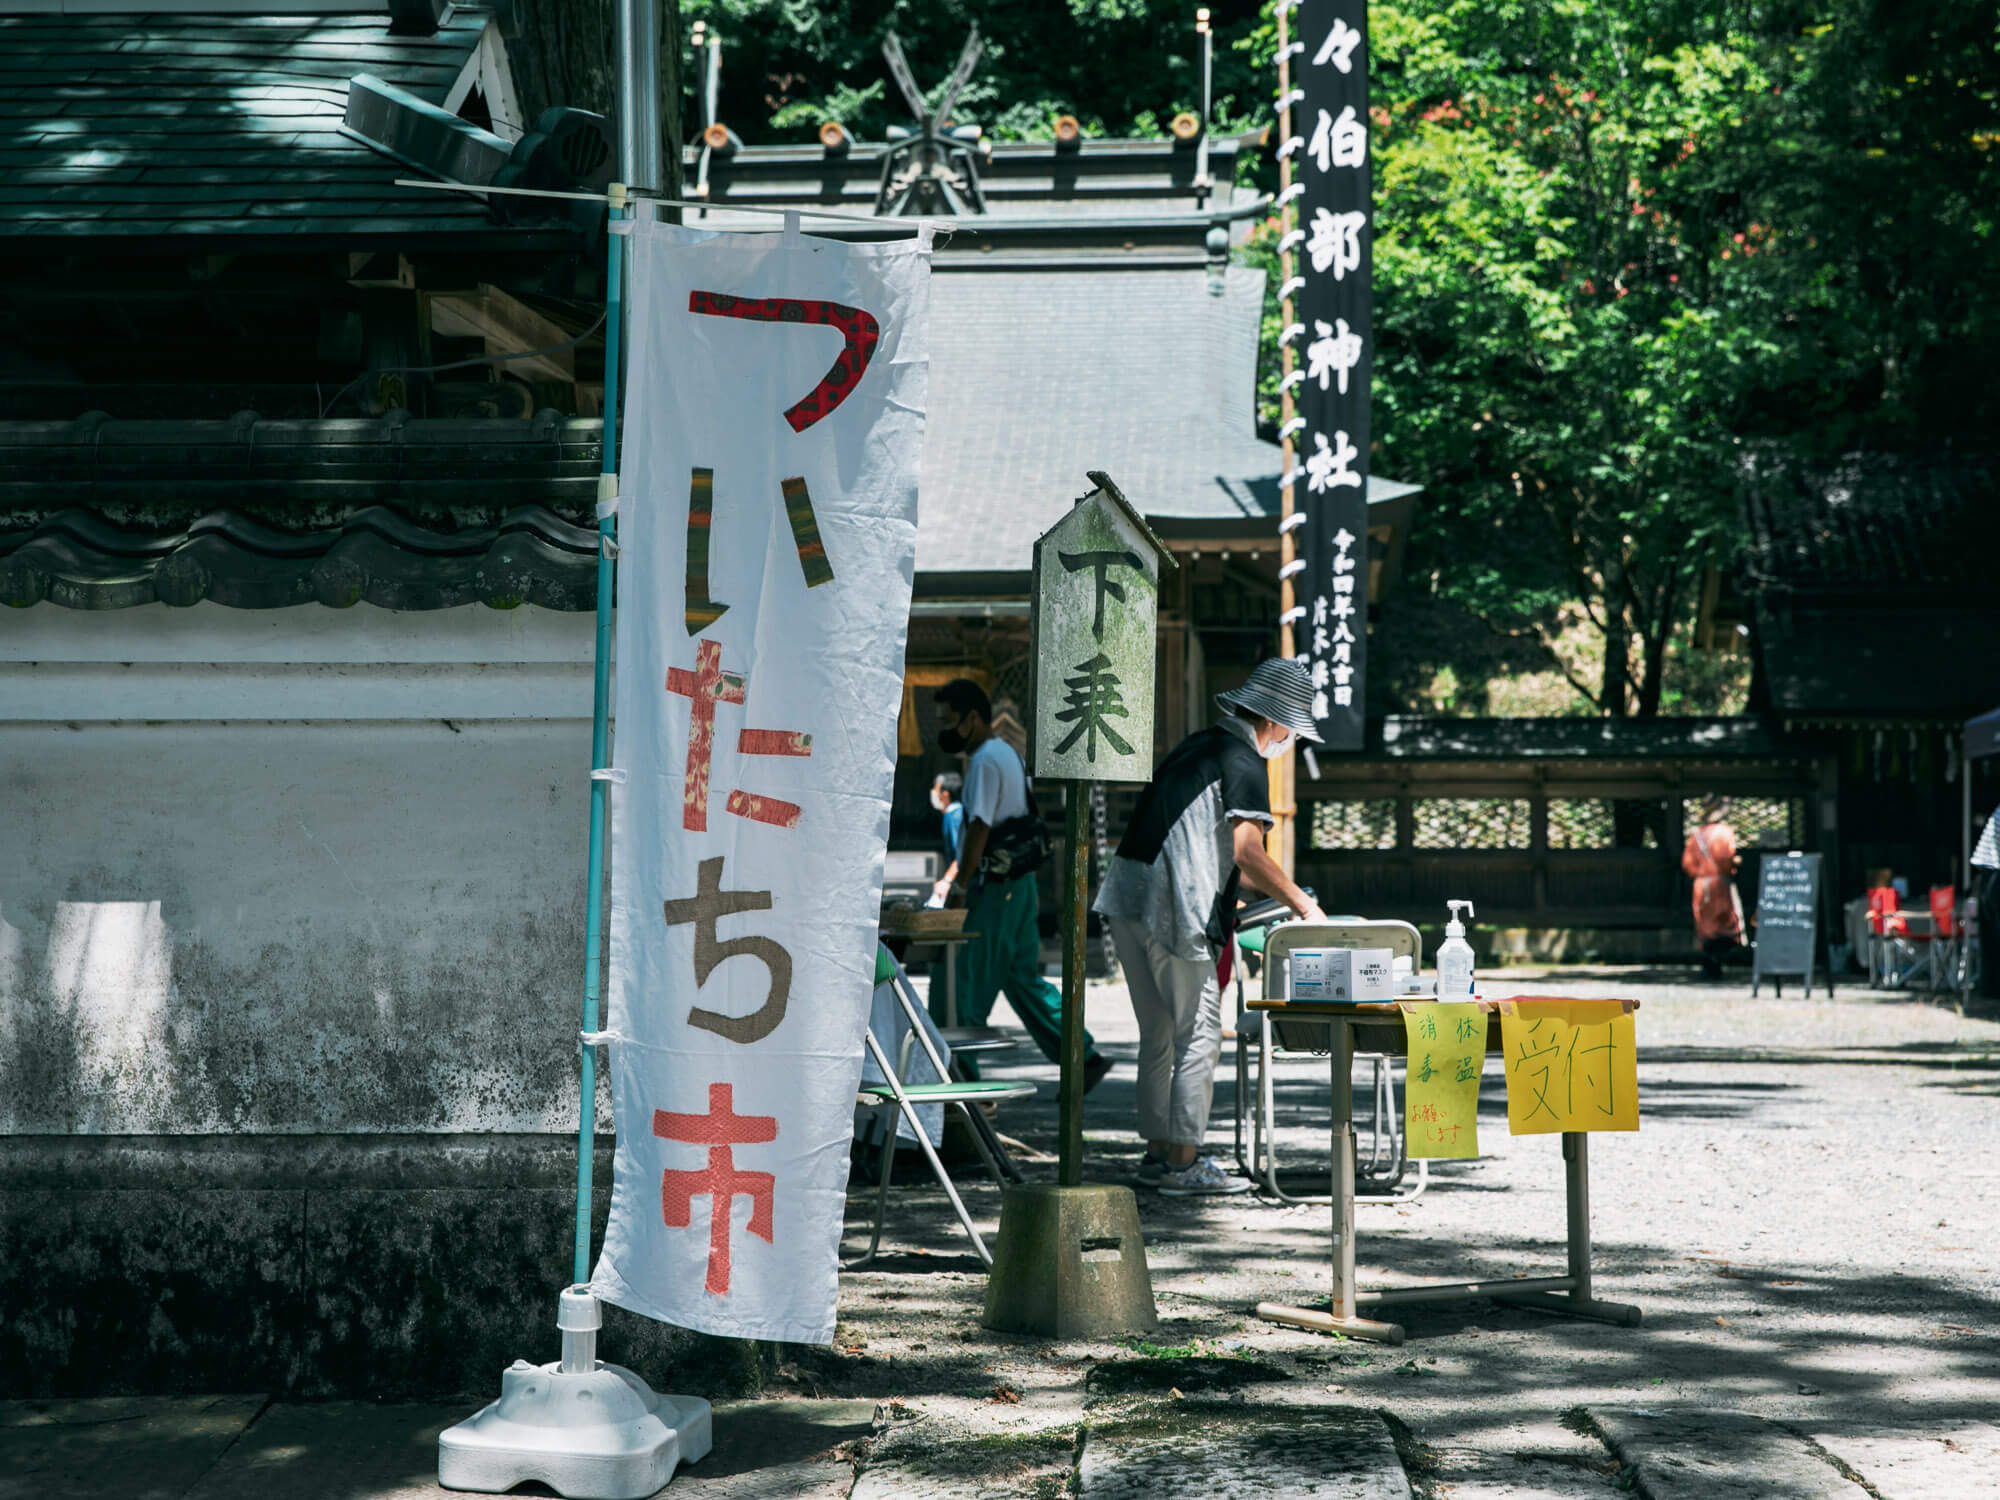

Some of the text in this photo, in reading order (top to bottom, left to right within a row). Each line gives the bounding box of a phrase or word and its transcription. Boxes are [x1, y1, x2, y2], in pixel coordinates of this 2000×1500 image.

[1307, 17, 1367, 495] 々伯部神社
[1053, 550, 1144, 763] 下乗
[652, 289, 880, 1297] ついたち市
[1417, 1013, 1438, 1083] 消毒
[1456, 1016, 1480, 1083] 体温
[1514, 1017, 1617, 1121] 受付
[1411, 1103, 1447, 1123] お願い
[1426, 1124, 1462, 1144] します
